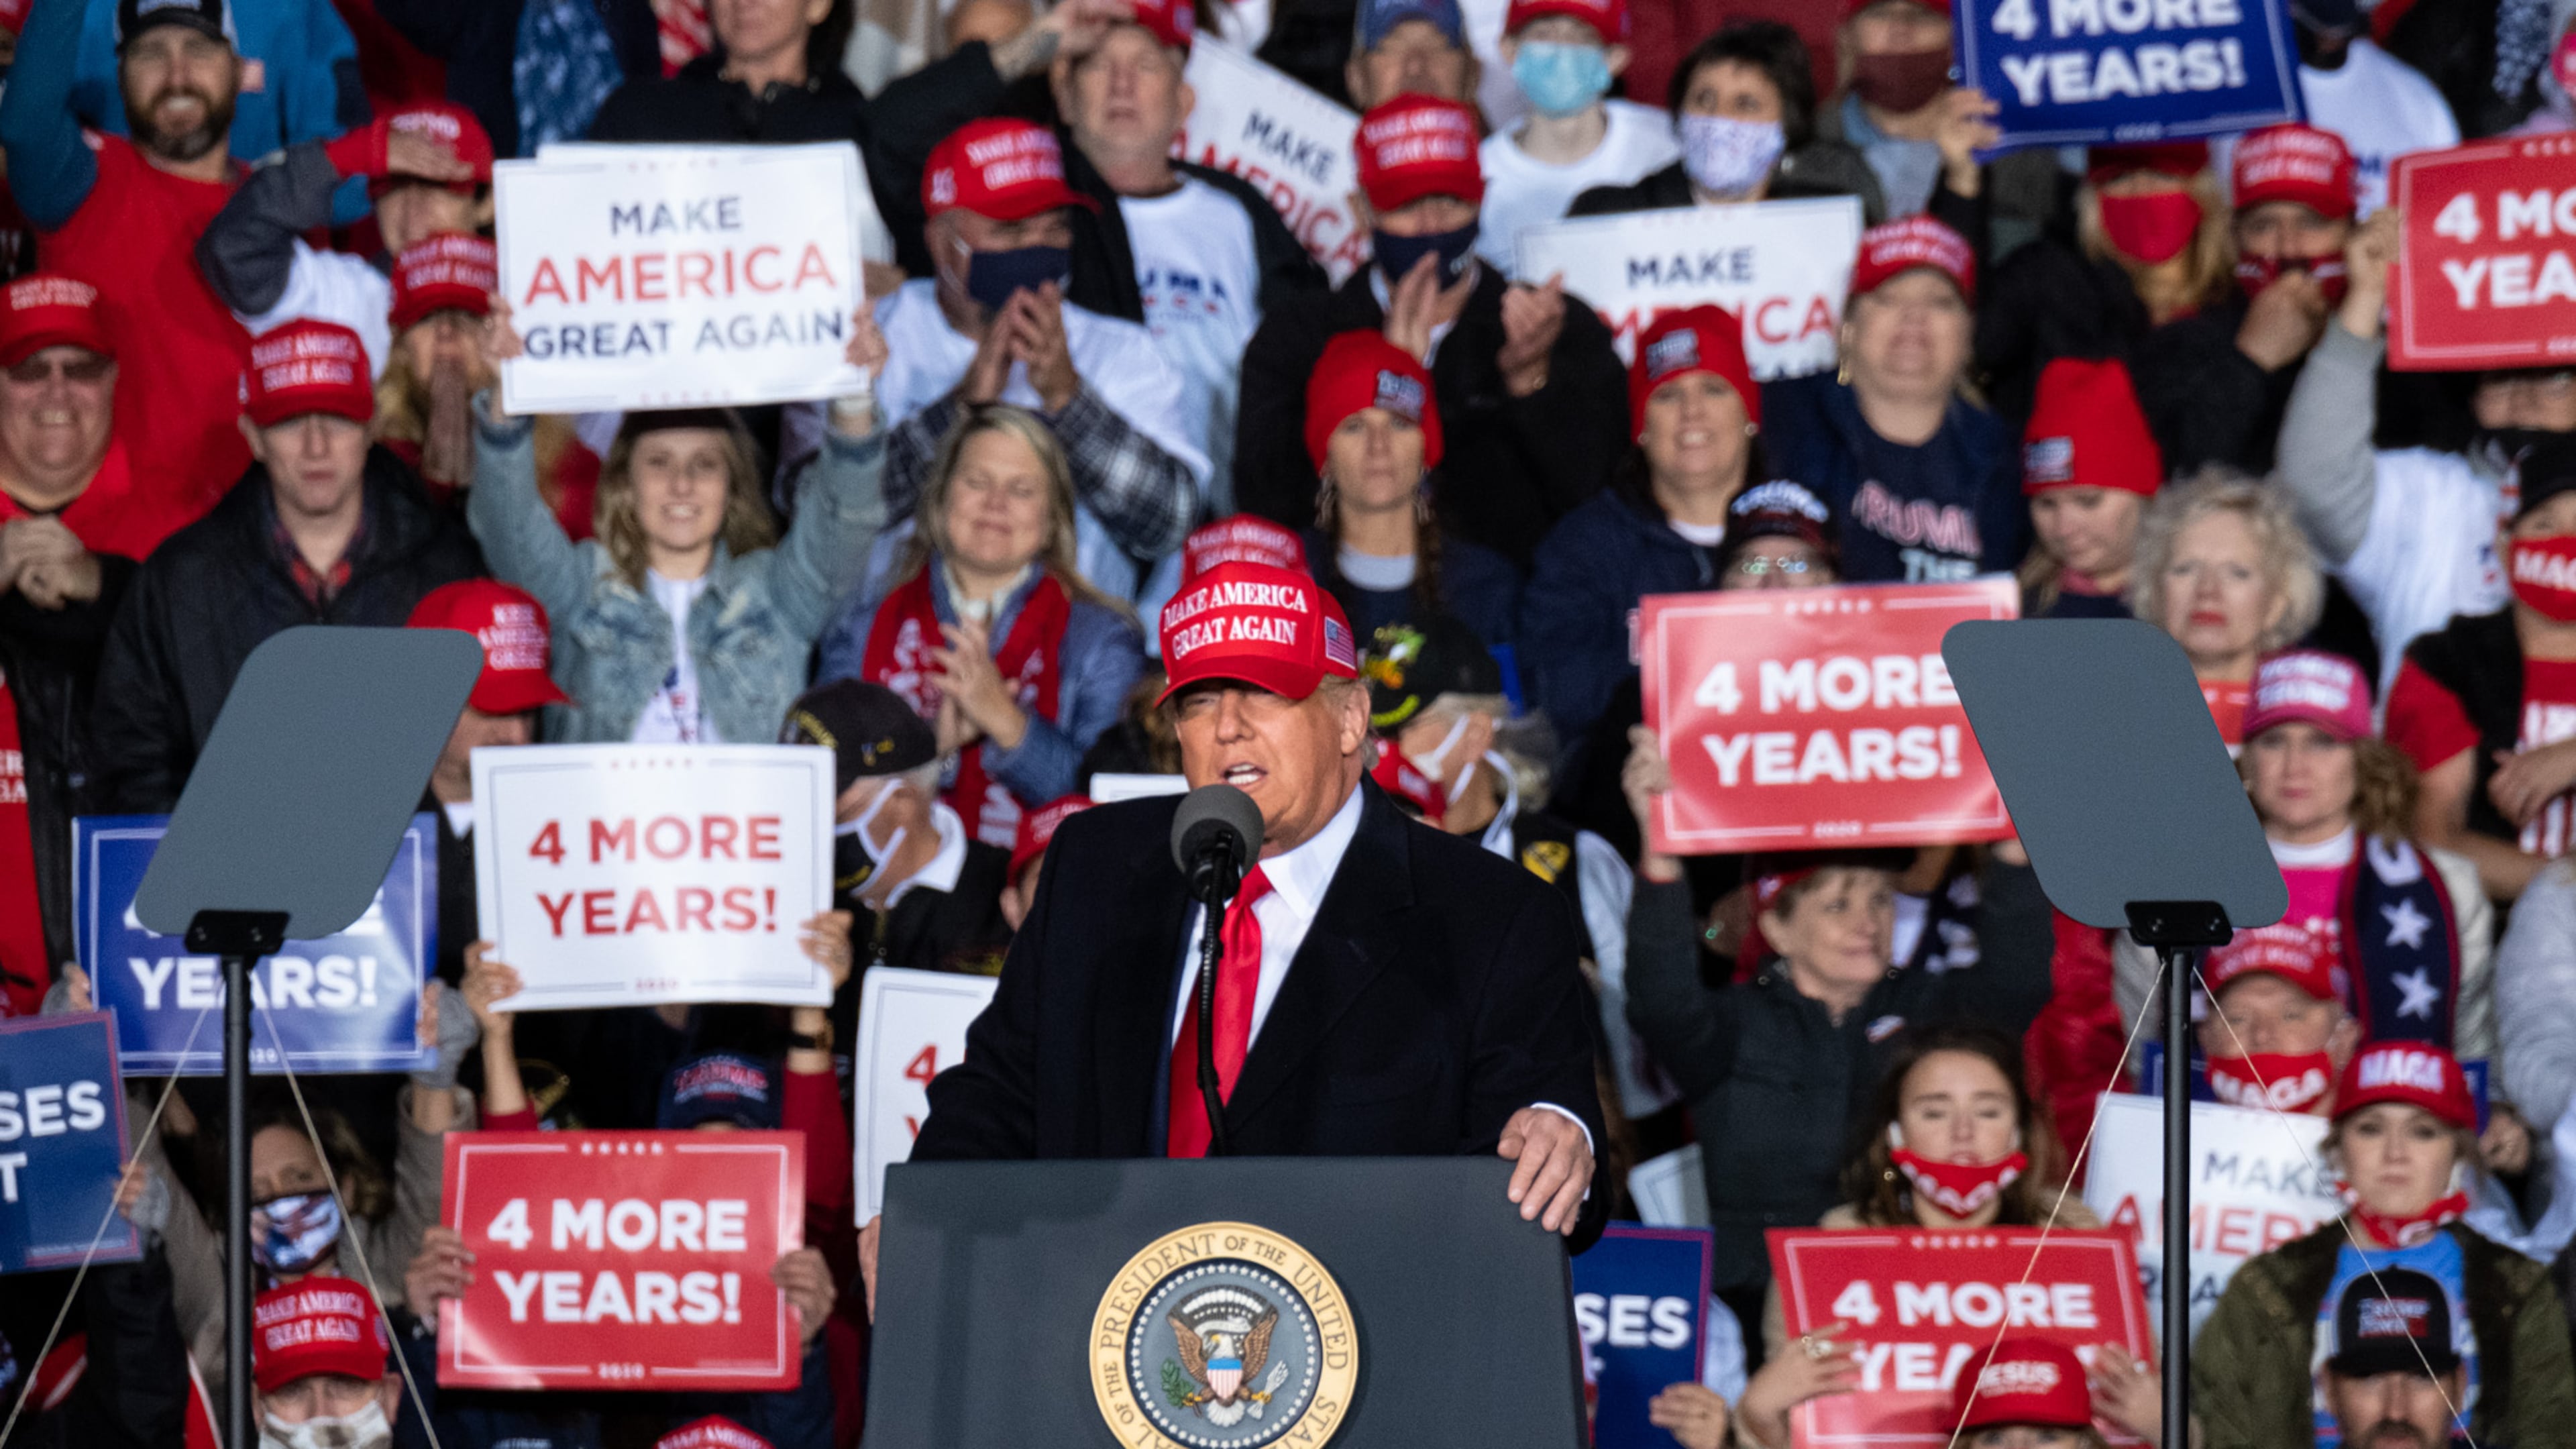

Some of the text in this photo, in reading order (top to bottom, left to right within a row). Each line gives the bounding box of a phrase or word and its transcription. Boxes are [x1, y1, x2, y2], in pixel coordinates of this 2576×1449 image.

[1992, 0, 2243, 40] 4 MORE
[2000, 37, 2247, 107] YEARS!
[1242, 109, 1336, 185] MAKE
[611, 196, 743, 236] MAKE
[2434, 193, 2482, 243] 4
[524, 240, 838, 307] AMERICA
[1626, 246, 1755, 288] MAKE
[525, 308, 844, 360] GREAT AGAIN
[1163, 581, 1308, 633] MAKE AMERICA
[1173, 614, 1297, 660] GREAT AGAIN
[1694, 653, 1962, 714] 4 MORE
[1701, 724, 1962, 786] YEARS!
[529, 816, 782, 865] 4 MORE
[536, 888, 777, 936] YEARS!
[2203, 1150, 2343, 1199] MAKE
[487, 1198, 747, 1251] 4 MORE
[1225, 1235, 1248, 1251] OF
[1254, 1240, 1288, 1266] THE
[493, 1271, 741, 1324] YEARS!
[1100, 1233, 1216, 1350] PRESIDENT
[1832, 1280, 1880, 1326] 4
[1893, 1280, 2098, 1328] MORE
[1293, 1263, 1348, 1371] UNITED
[1104, 1361, 1123, 1396] THE
[1114, 1397, 1134, 1425] OF
